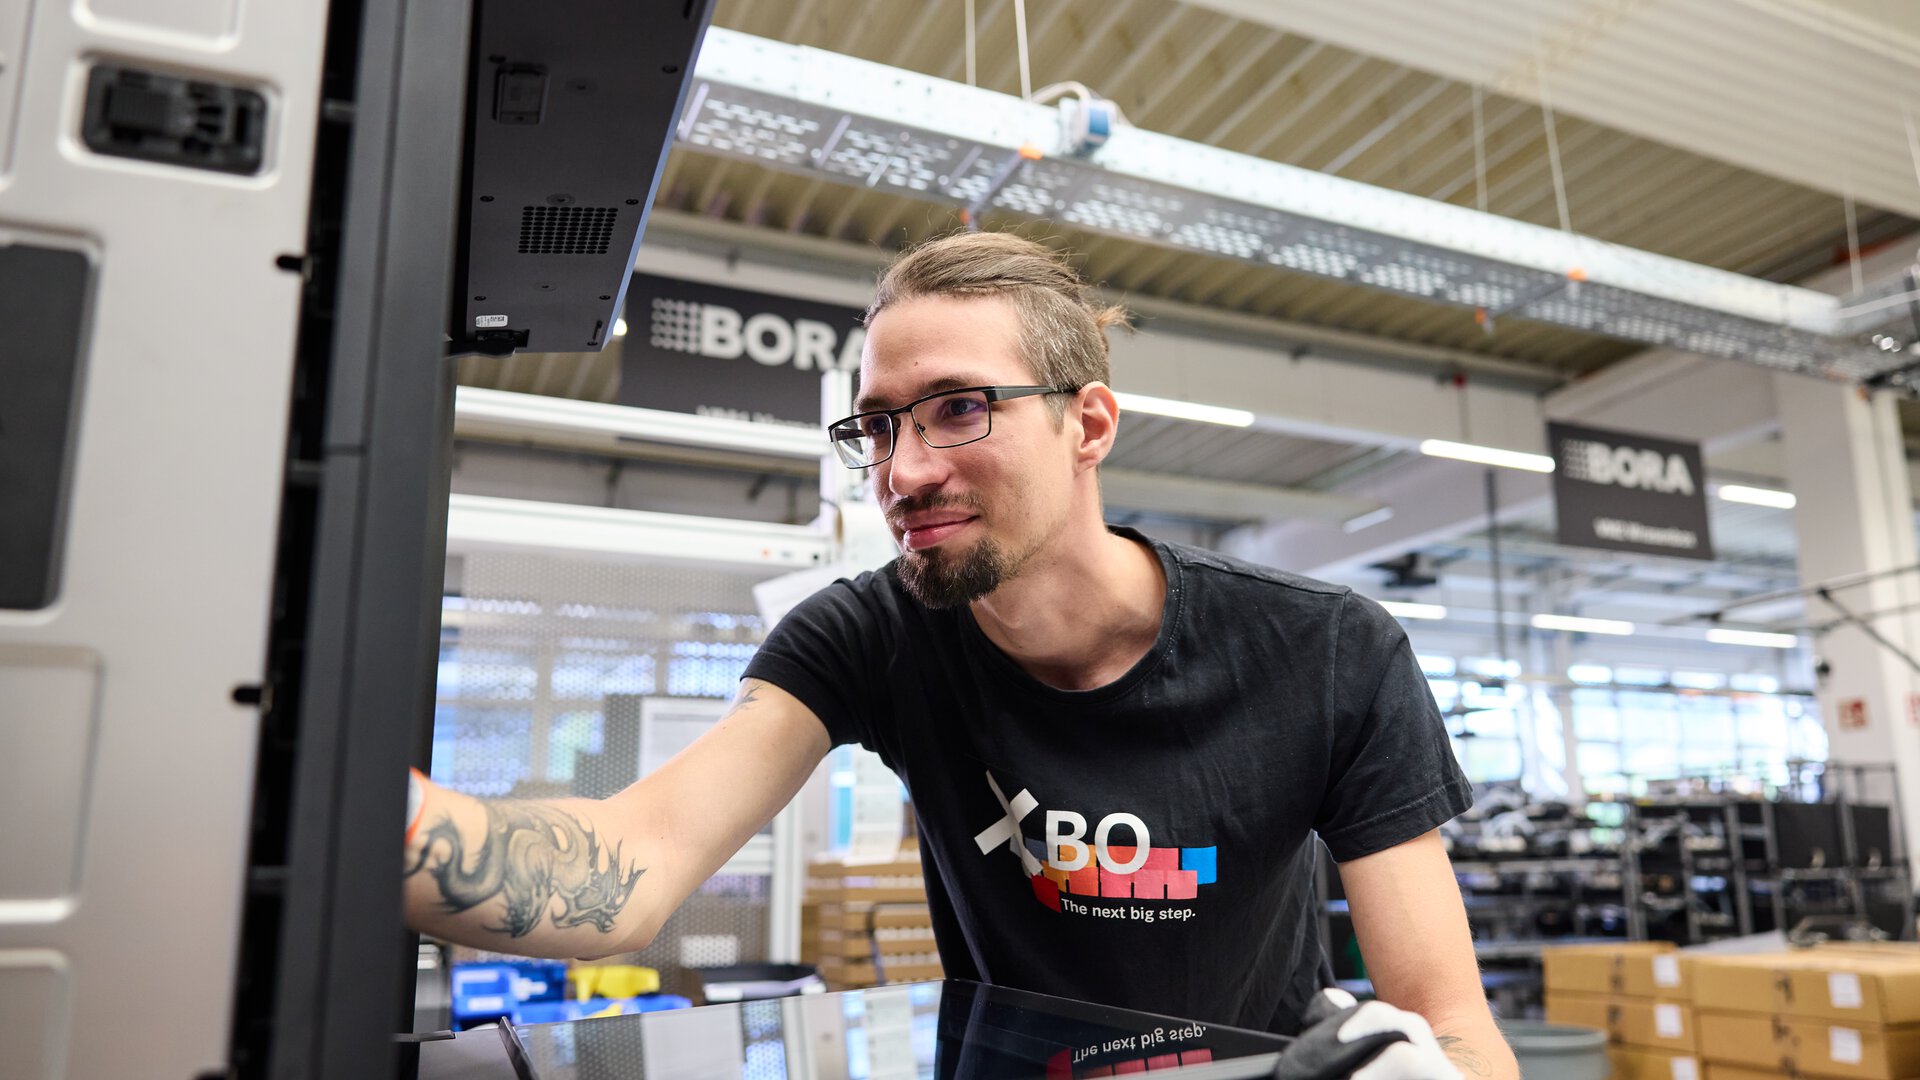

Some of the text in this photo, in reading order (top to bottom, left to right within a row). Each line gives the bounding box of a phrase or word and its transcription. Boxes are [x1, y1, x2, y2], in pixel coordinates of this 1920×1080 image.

[1587, 441, 1696, 497] BORA
[1061, 898, 1197, 923] The next big step.
